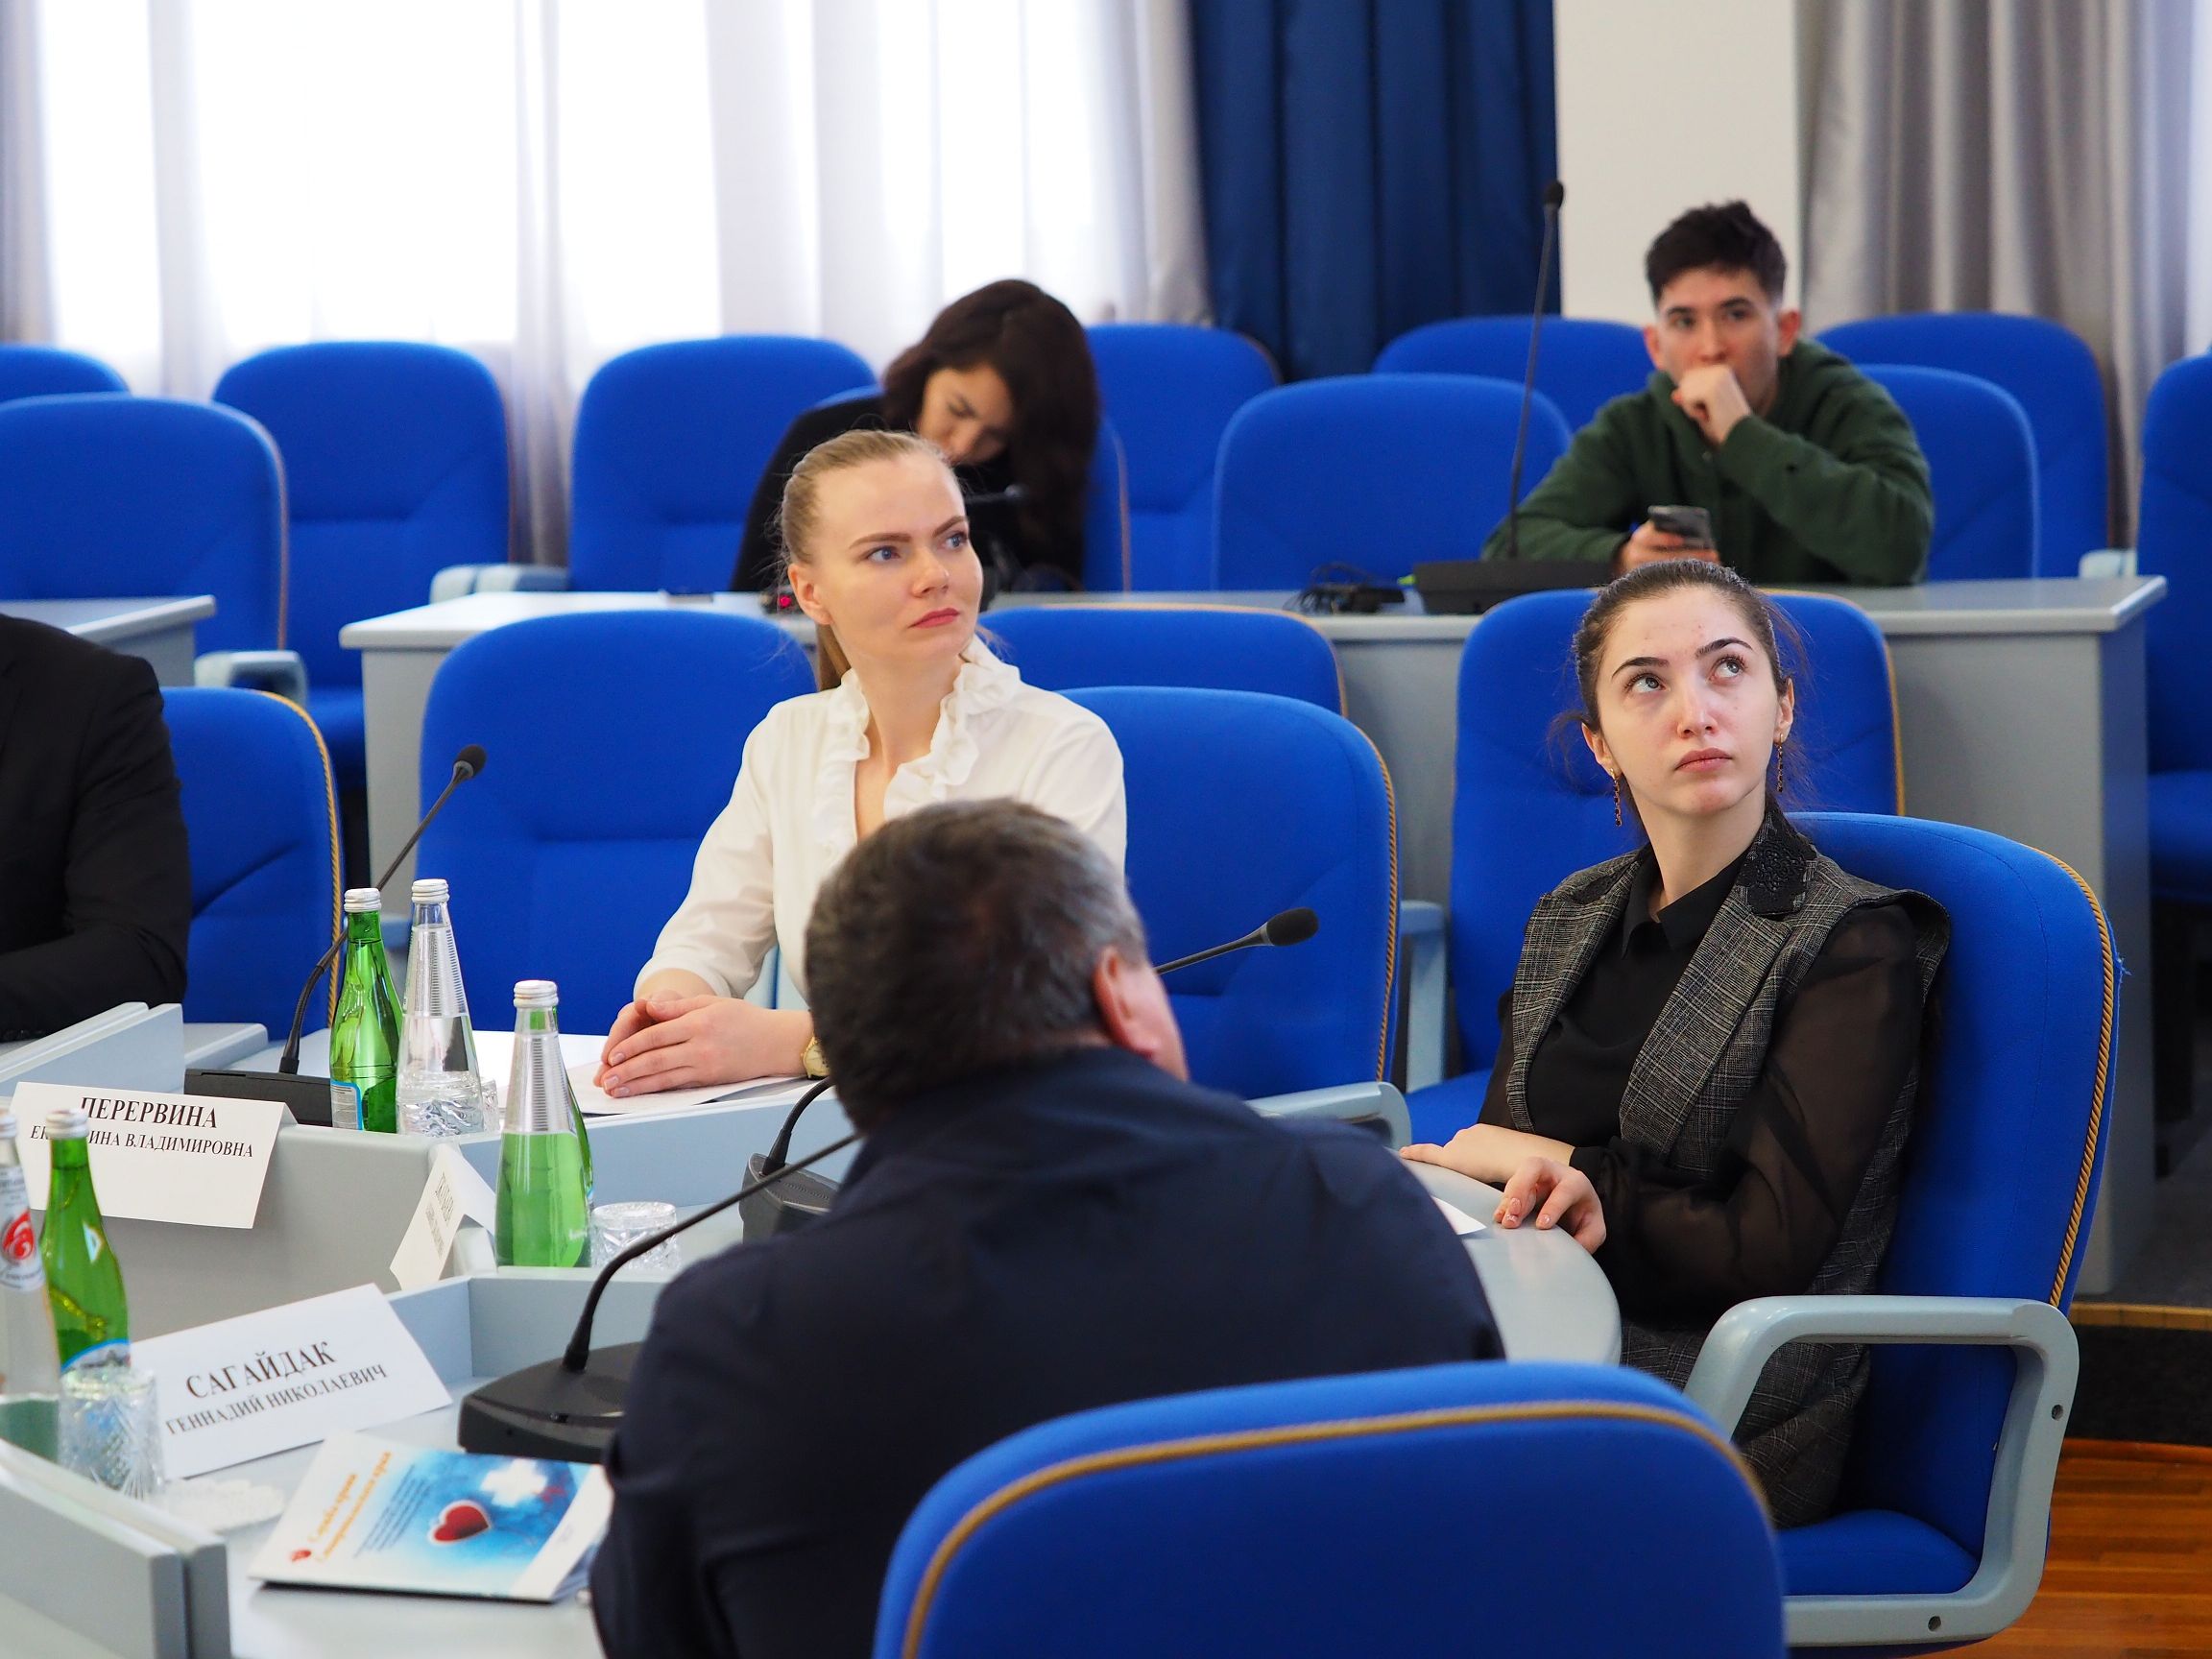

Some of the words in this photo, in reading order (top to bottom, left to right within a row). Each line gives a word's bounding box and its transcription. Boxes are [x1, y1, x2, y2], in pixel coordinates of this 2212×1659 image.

[81, 1096, 218, 1129] ПЕРЕРВИНА
[30, 1125, 120, 1146] ЕКИНА
[125, 1133, 253, 1158] ВЛАДИМИРОВНА
[185, 1340, 338, 1399] САГАЙДАК
[165, 1394, 265, 1435] ГЕННАДИЙ
[266, 1363, 389, 1409] НИКОЛАЕВИЧ
